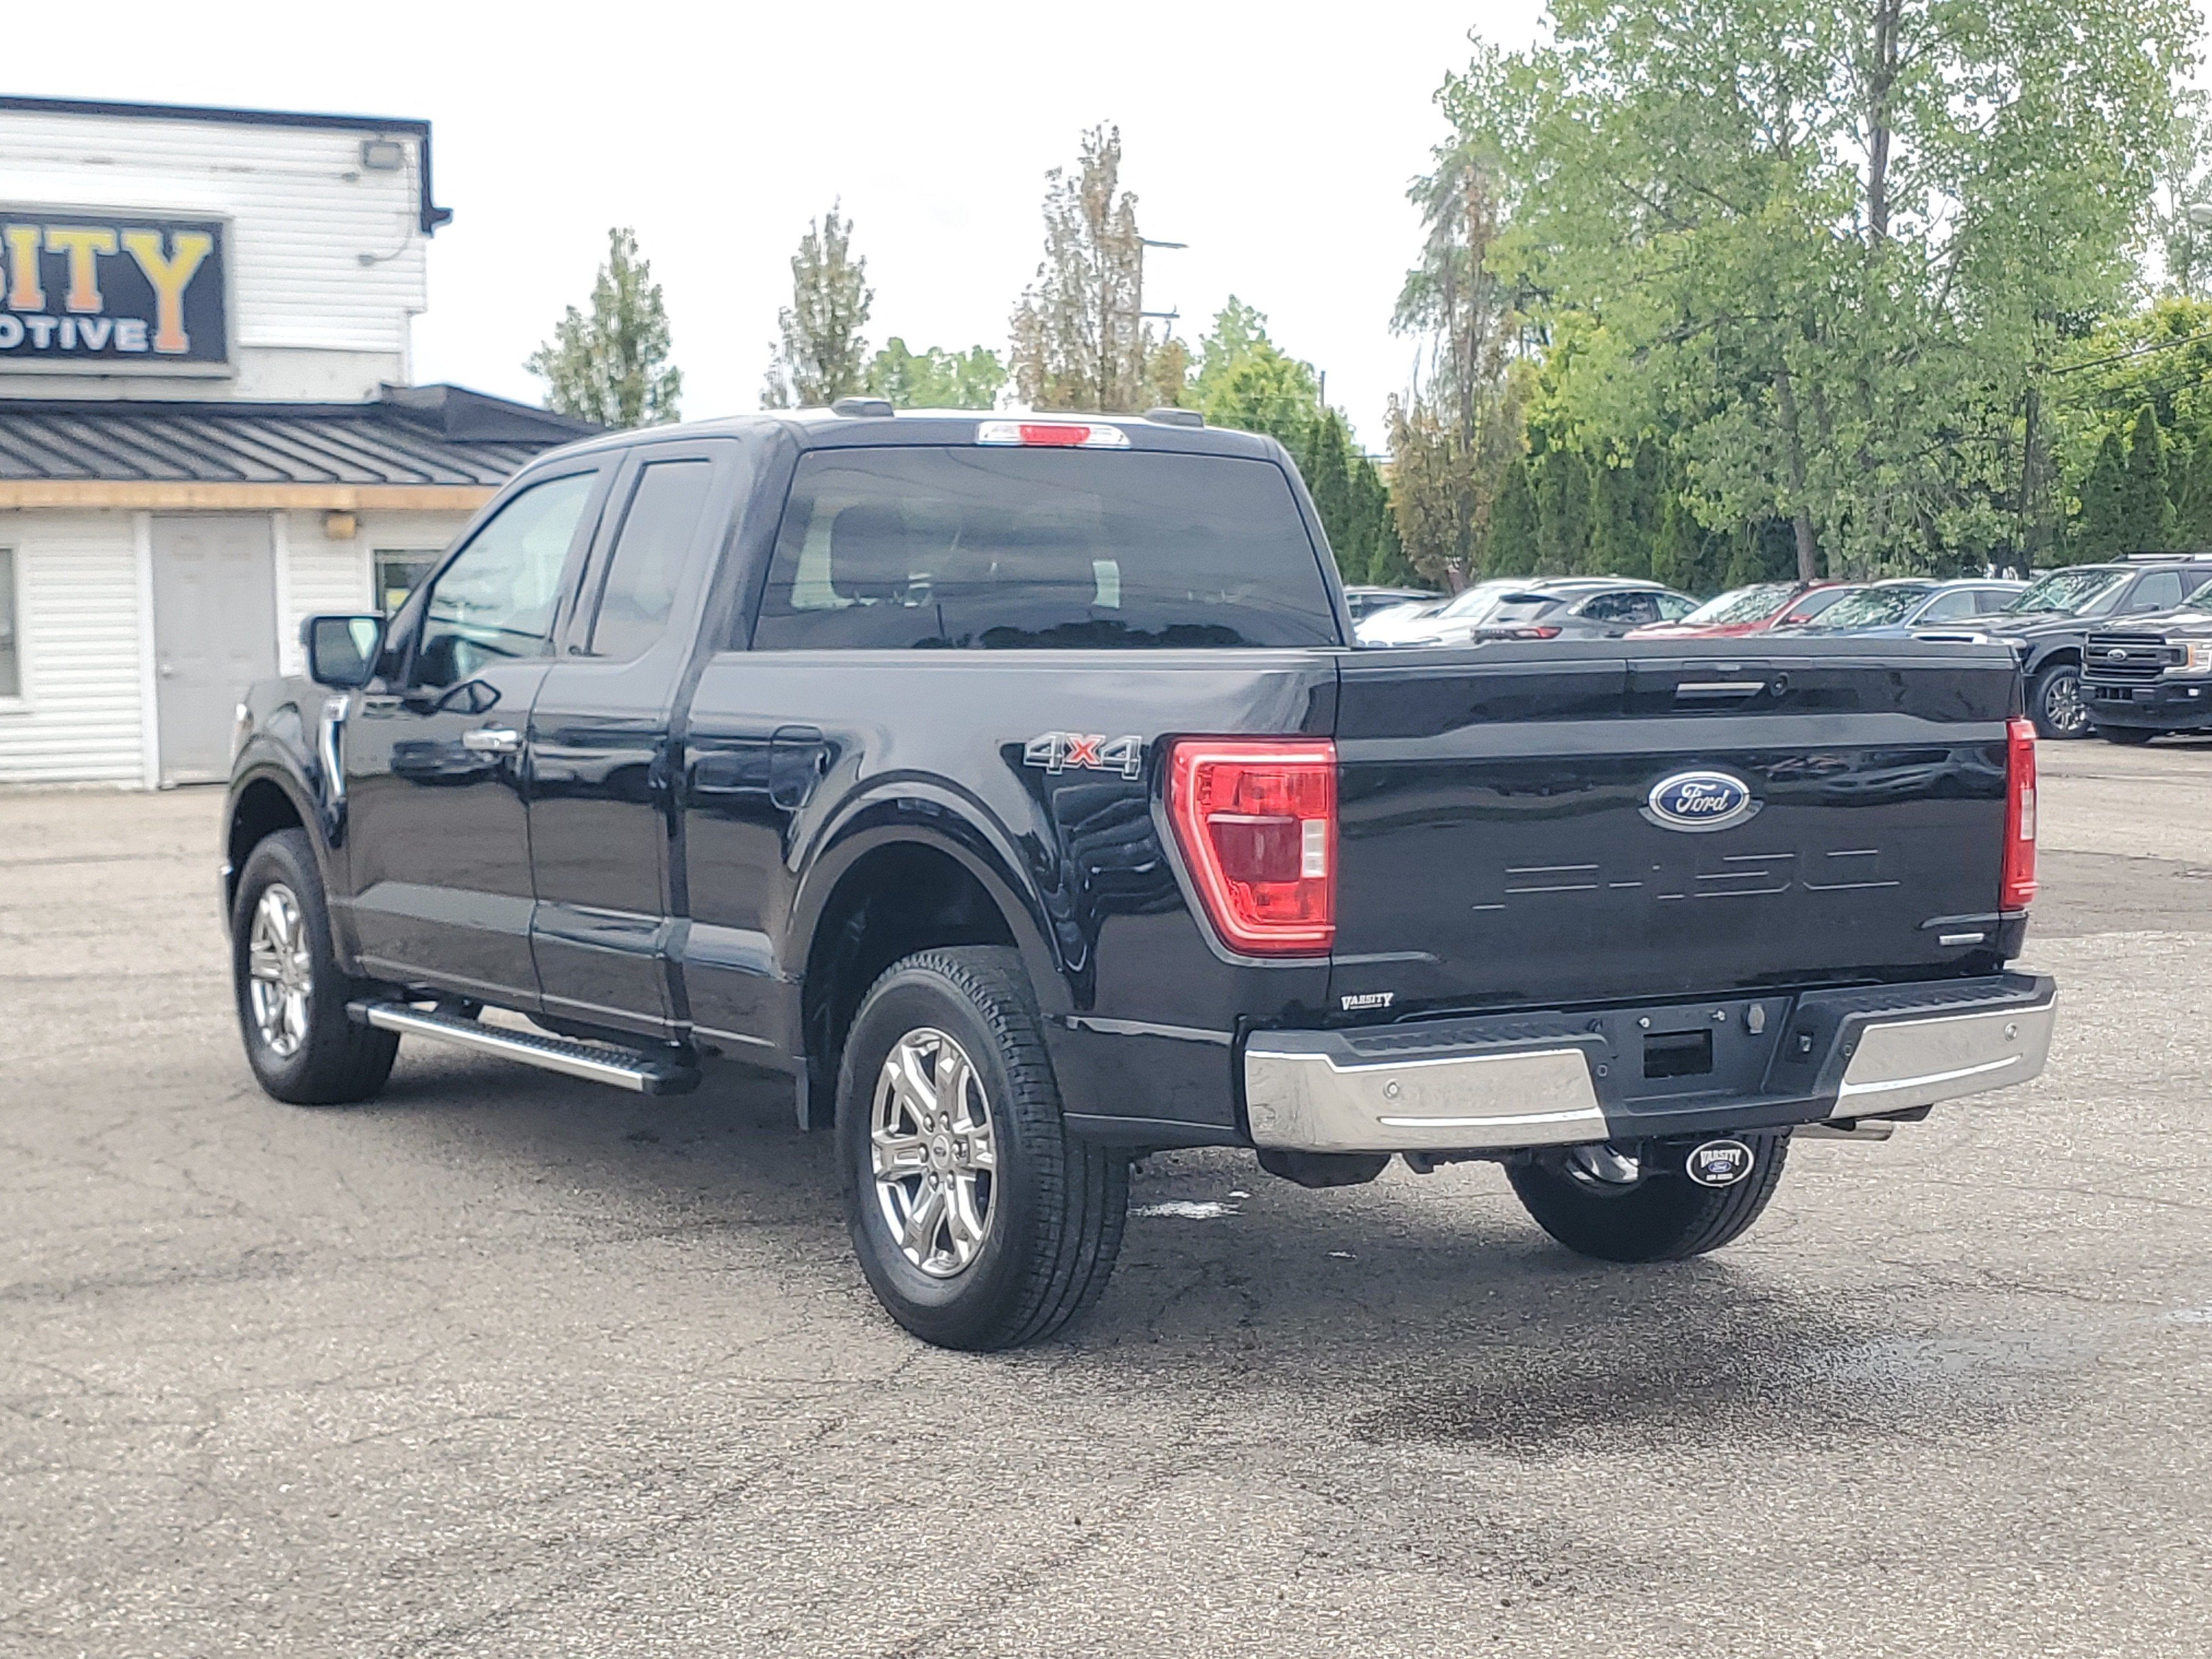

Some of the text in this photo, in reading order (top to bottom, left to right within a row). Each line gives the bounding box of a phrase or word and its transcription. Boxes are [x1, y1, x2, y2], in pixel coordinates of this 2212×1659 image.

[0, 224, 213, 354] ITY
[1676, 783, 1730, 812] Ford
[1341, 992, 1394, 1011] VARSITY
[1700, 1149, 1741, 1169] VARSITY
